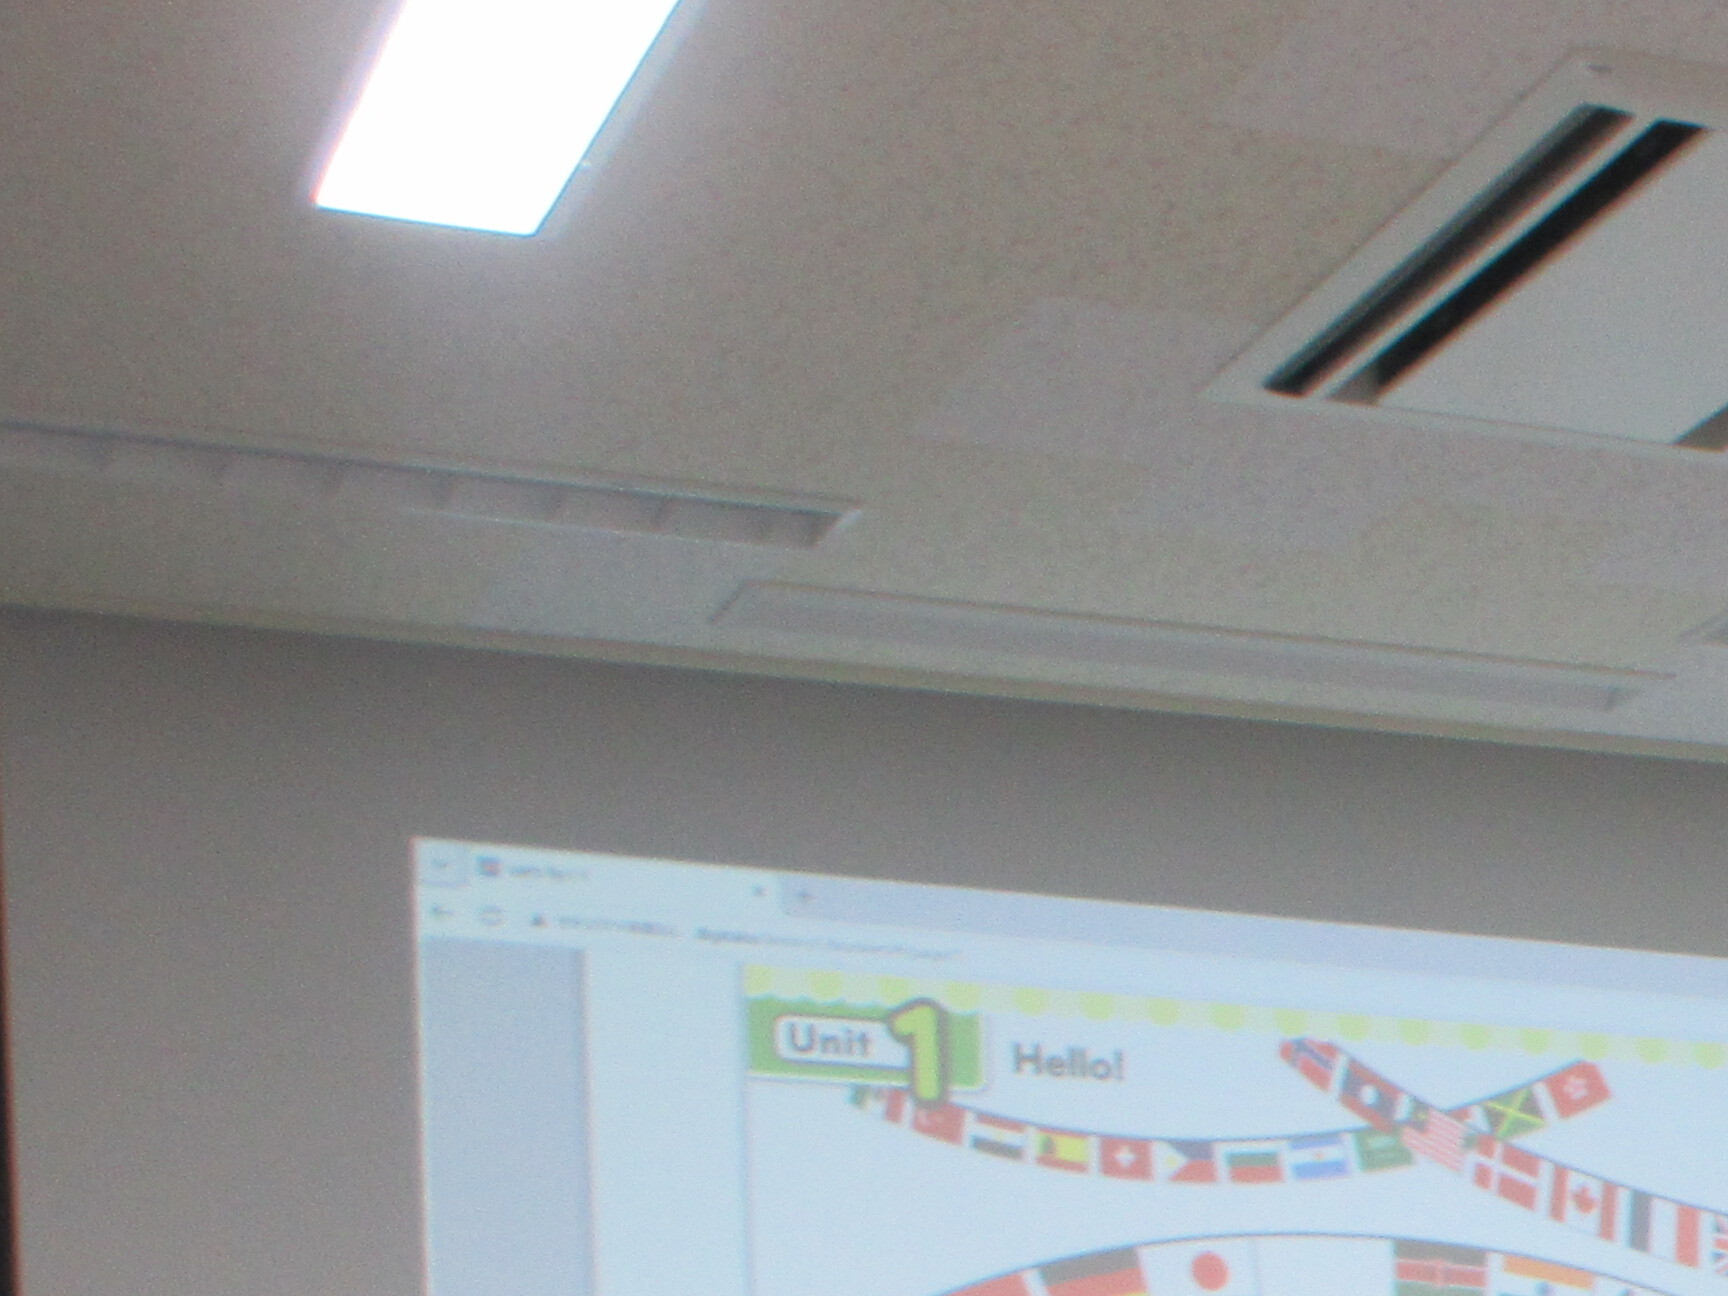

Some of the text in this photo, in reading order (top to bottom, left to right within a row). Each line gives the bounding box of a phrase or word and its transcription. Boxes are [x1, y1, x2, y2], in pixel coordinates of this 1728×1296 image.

[788, 998, 1126, 1106] Unit 1 Hello!
